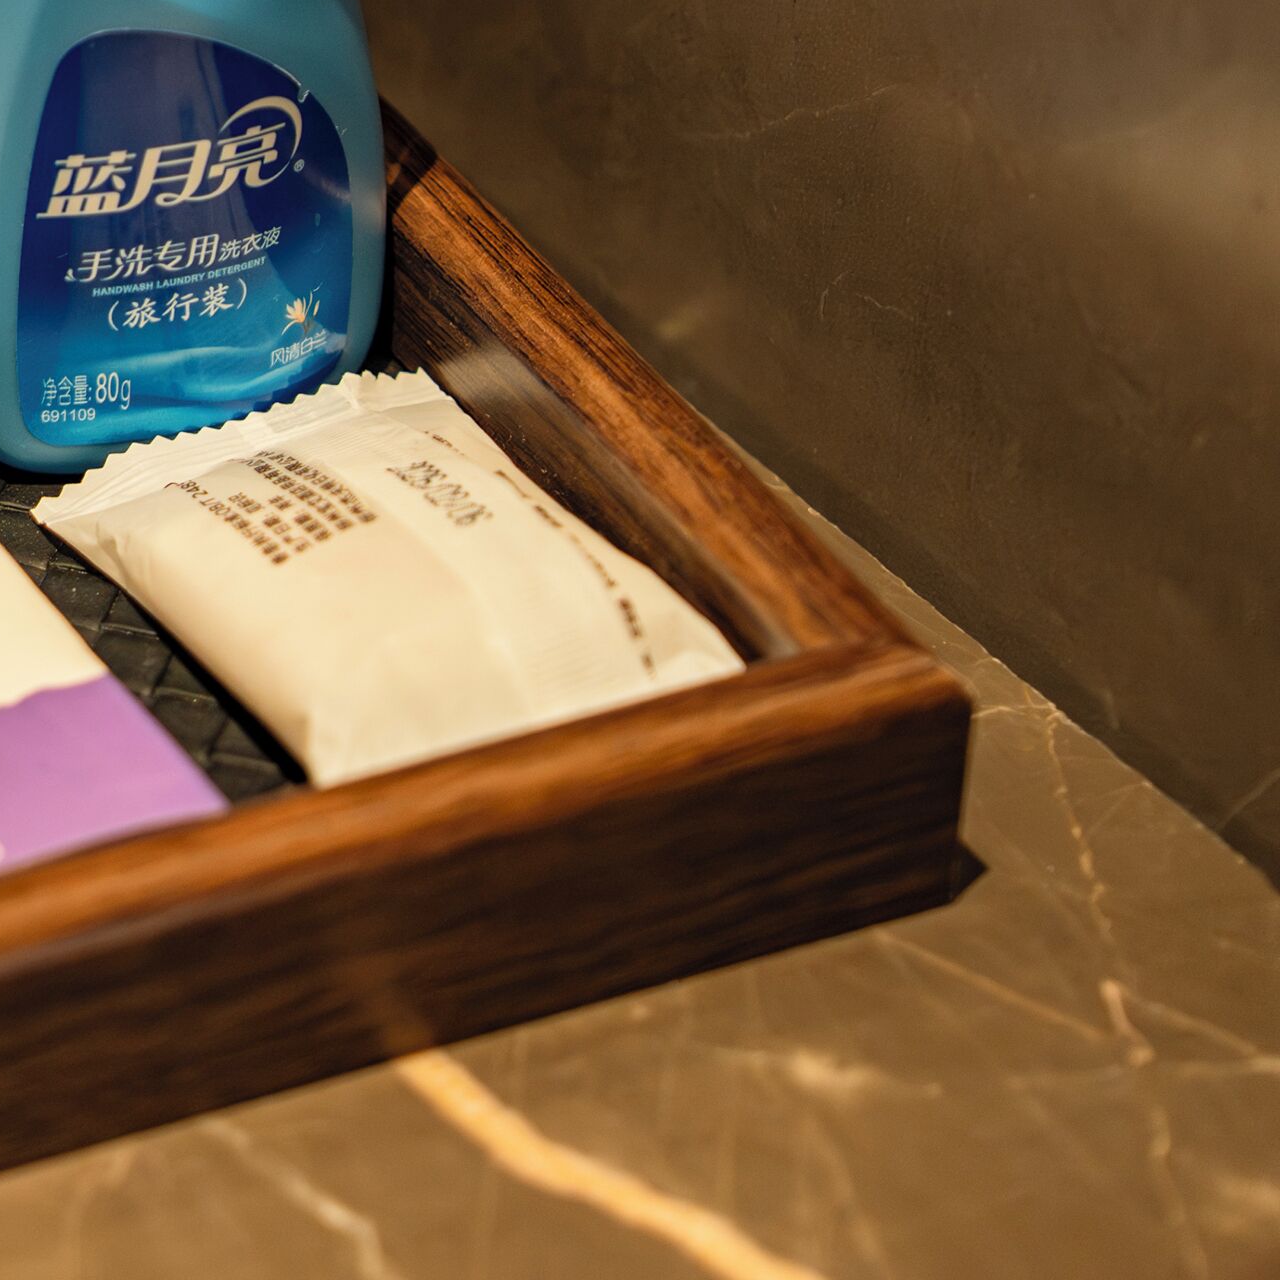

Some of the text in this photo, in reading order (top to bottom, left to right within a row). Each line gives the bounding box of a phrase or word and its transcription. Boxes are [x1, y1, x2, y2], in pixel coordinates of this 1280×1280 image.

[36, 99, 302, 219] 蓝月亮
[92, 256, 267, 297] HANDWASH LAUNDRY DETERGENT
[108, 277, 247, 331] （旅行装）
[270, 328, 328, 368] 风清白兰
[41, 407, 96, 423] 691109
